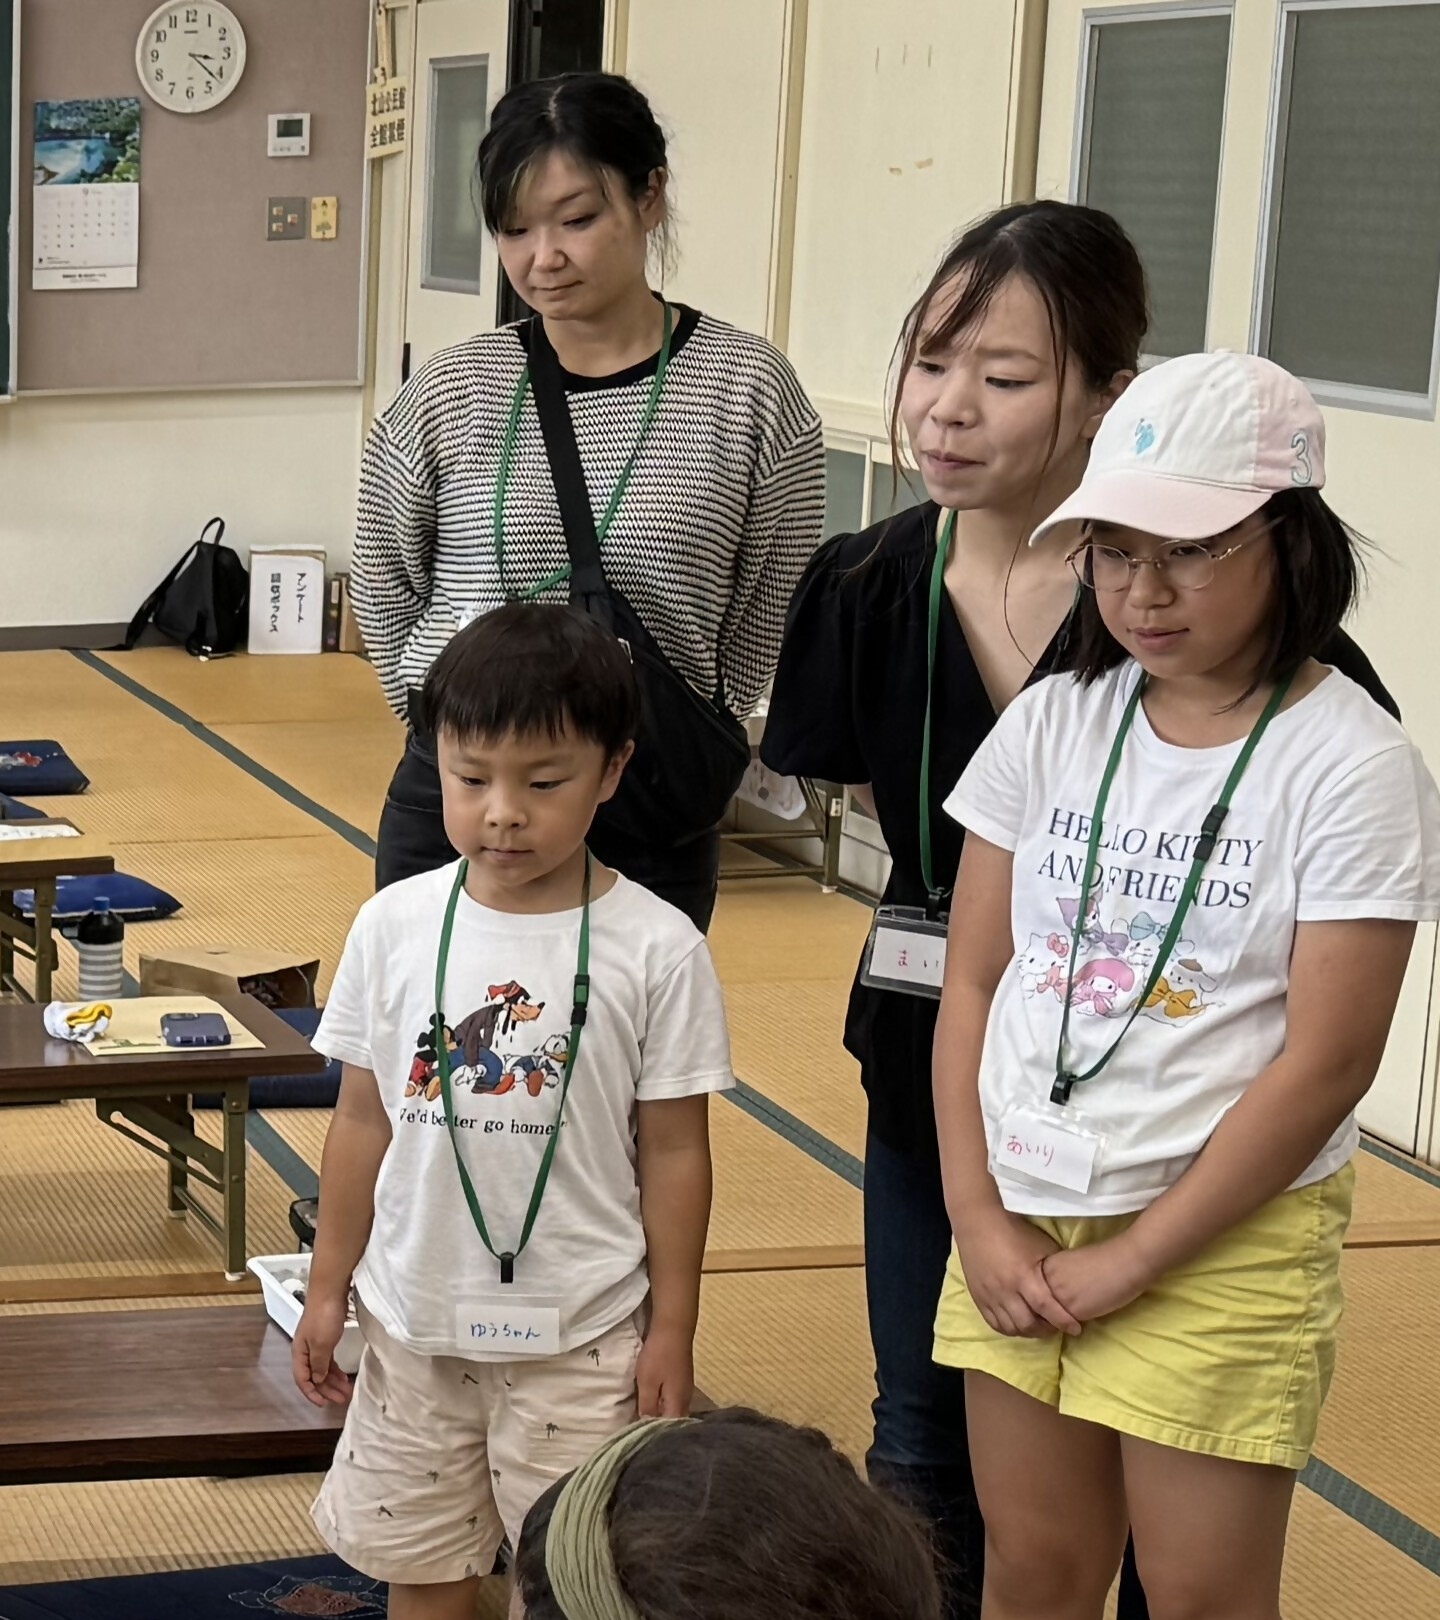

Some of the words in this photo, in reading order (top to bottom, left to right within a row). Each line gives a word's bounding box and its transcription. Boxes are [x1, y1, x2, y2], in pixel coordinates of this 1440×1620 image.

[168, 15, 177, 28] 11
[185, 9, 198, 23] 12
[155, 29, 167, 43] 10
[218, 27, 227, 41] 2
[150, 49, 159, 63] 9
[222, 46, 231, 60] 3
[155, 68, 163, 81] 8
[216, 65, 223, 79] 4
[168, 82, 176, 95] 7
[186, 86, 194, 99] 6
[204, 81, 212, 94] 5
[1291, 428, 1313, 486] 3
[1152, 831, 1264, 868] KITY
[431, 1111, 477, 1129] beter
[484, 1119, 504, 1133] go
[1006, 1135, 1054, 1168] あいり
[470, 1323, 541, 1341] ゆうちゃん
